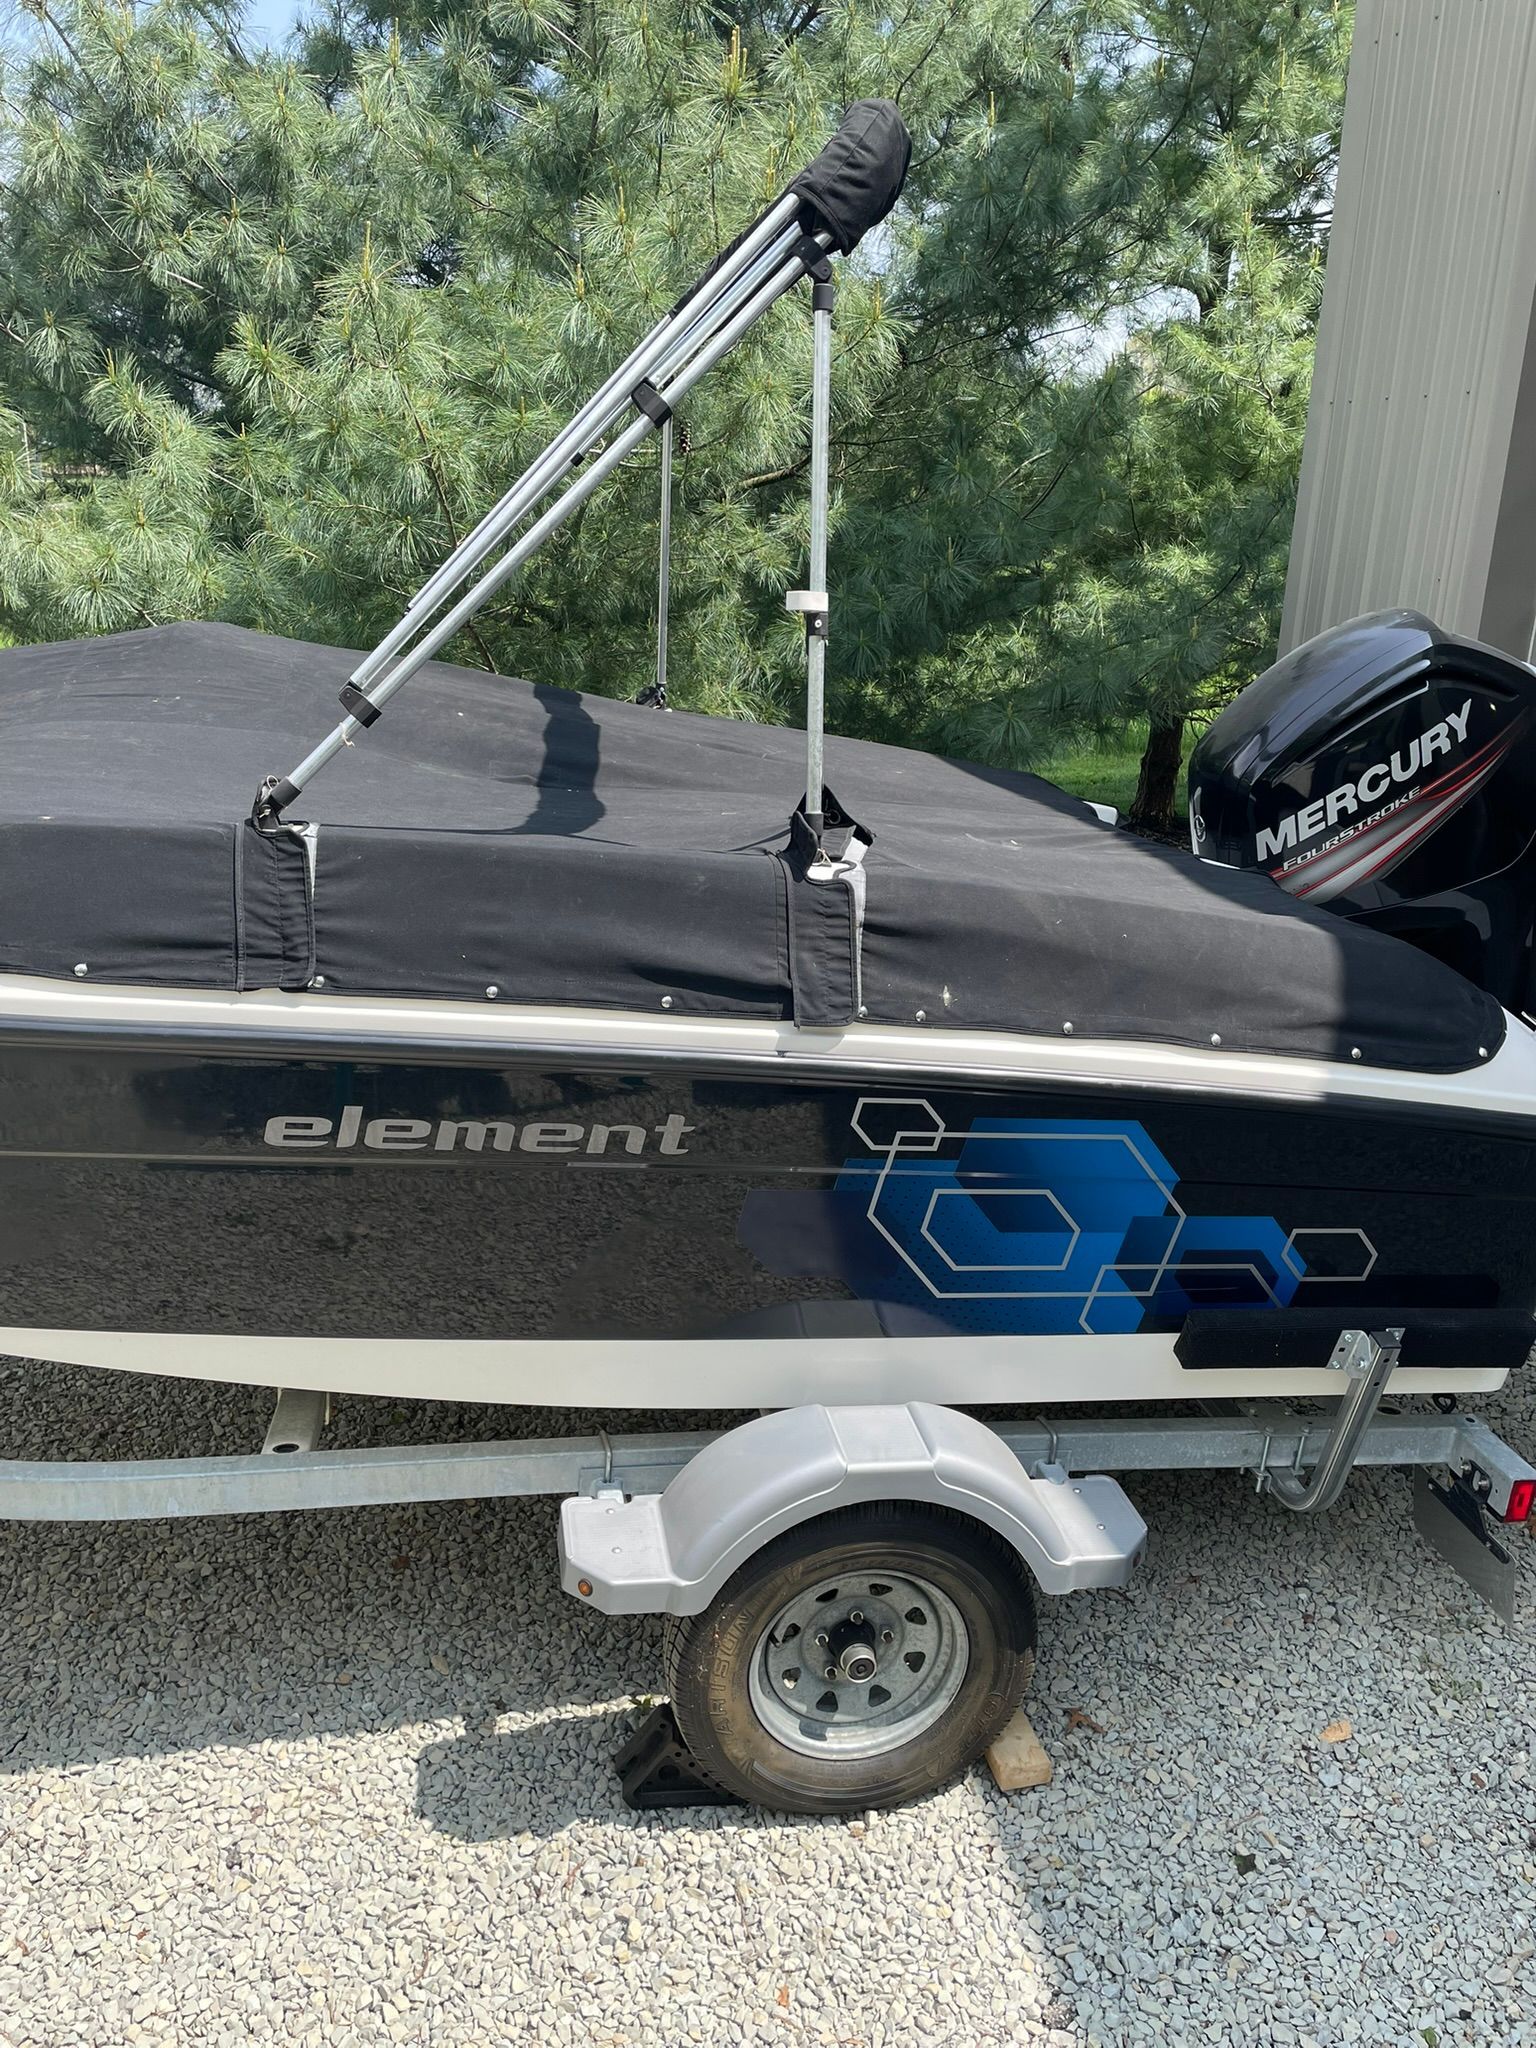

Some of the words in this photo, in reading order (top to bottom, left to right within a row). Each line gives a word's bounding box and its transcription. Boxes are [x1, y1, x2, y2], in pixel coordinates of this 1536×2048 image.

[1256, 698, 1472, 862] MERCURY
[1283, 787, 1423, 872] FOURSTROKE
[263, 1105, 696, 1155] element
